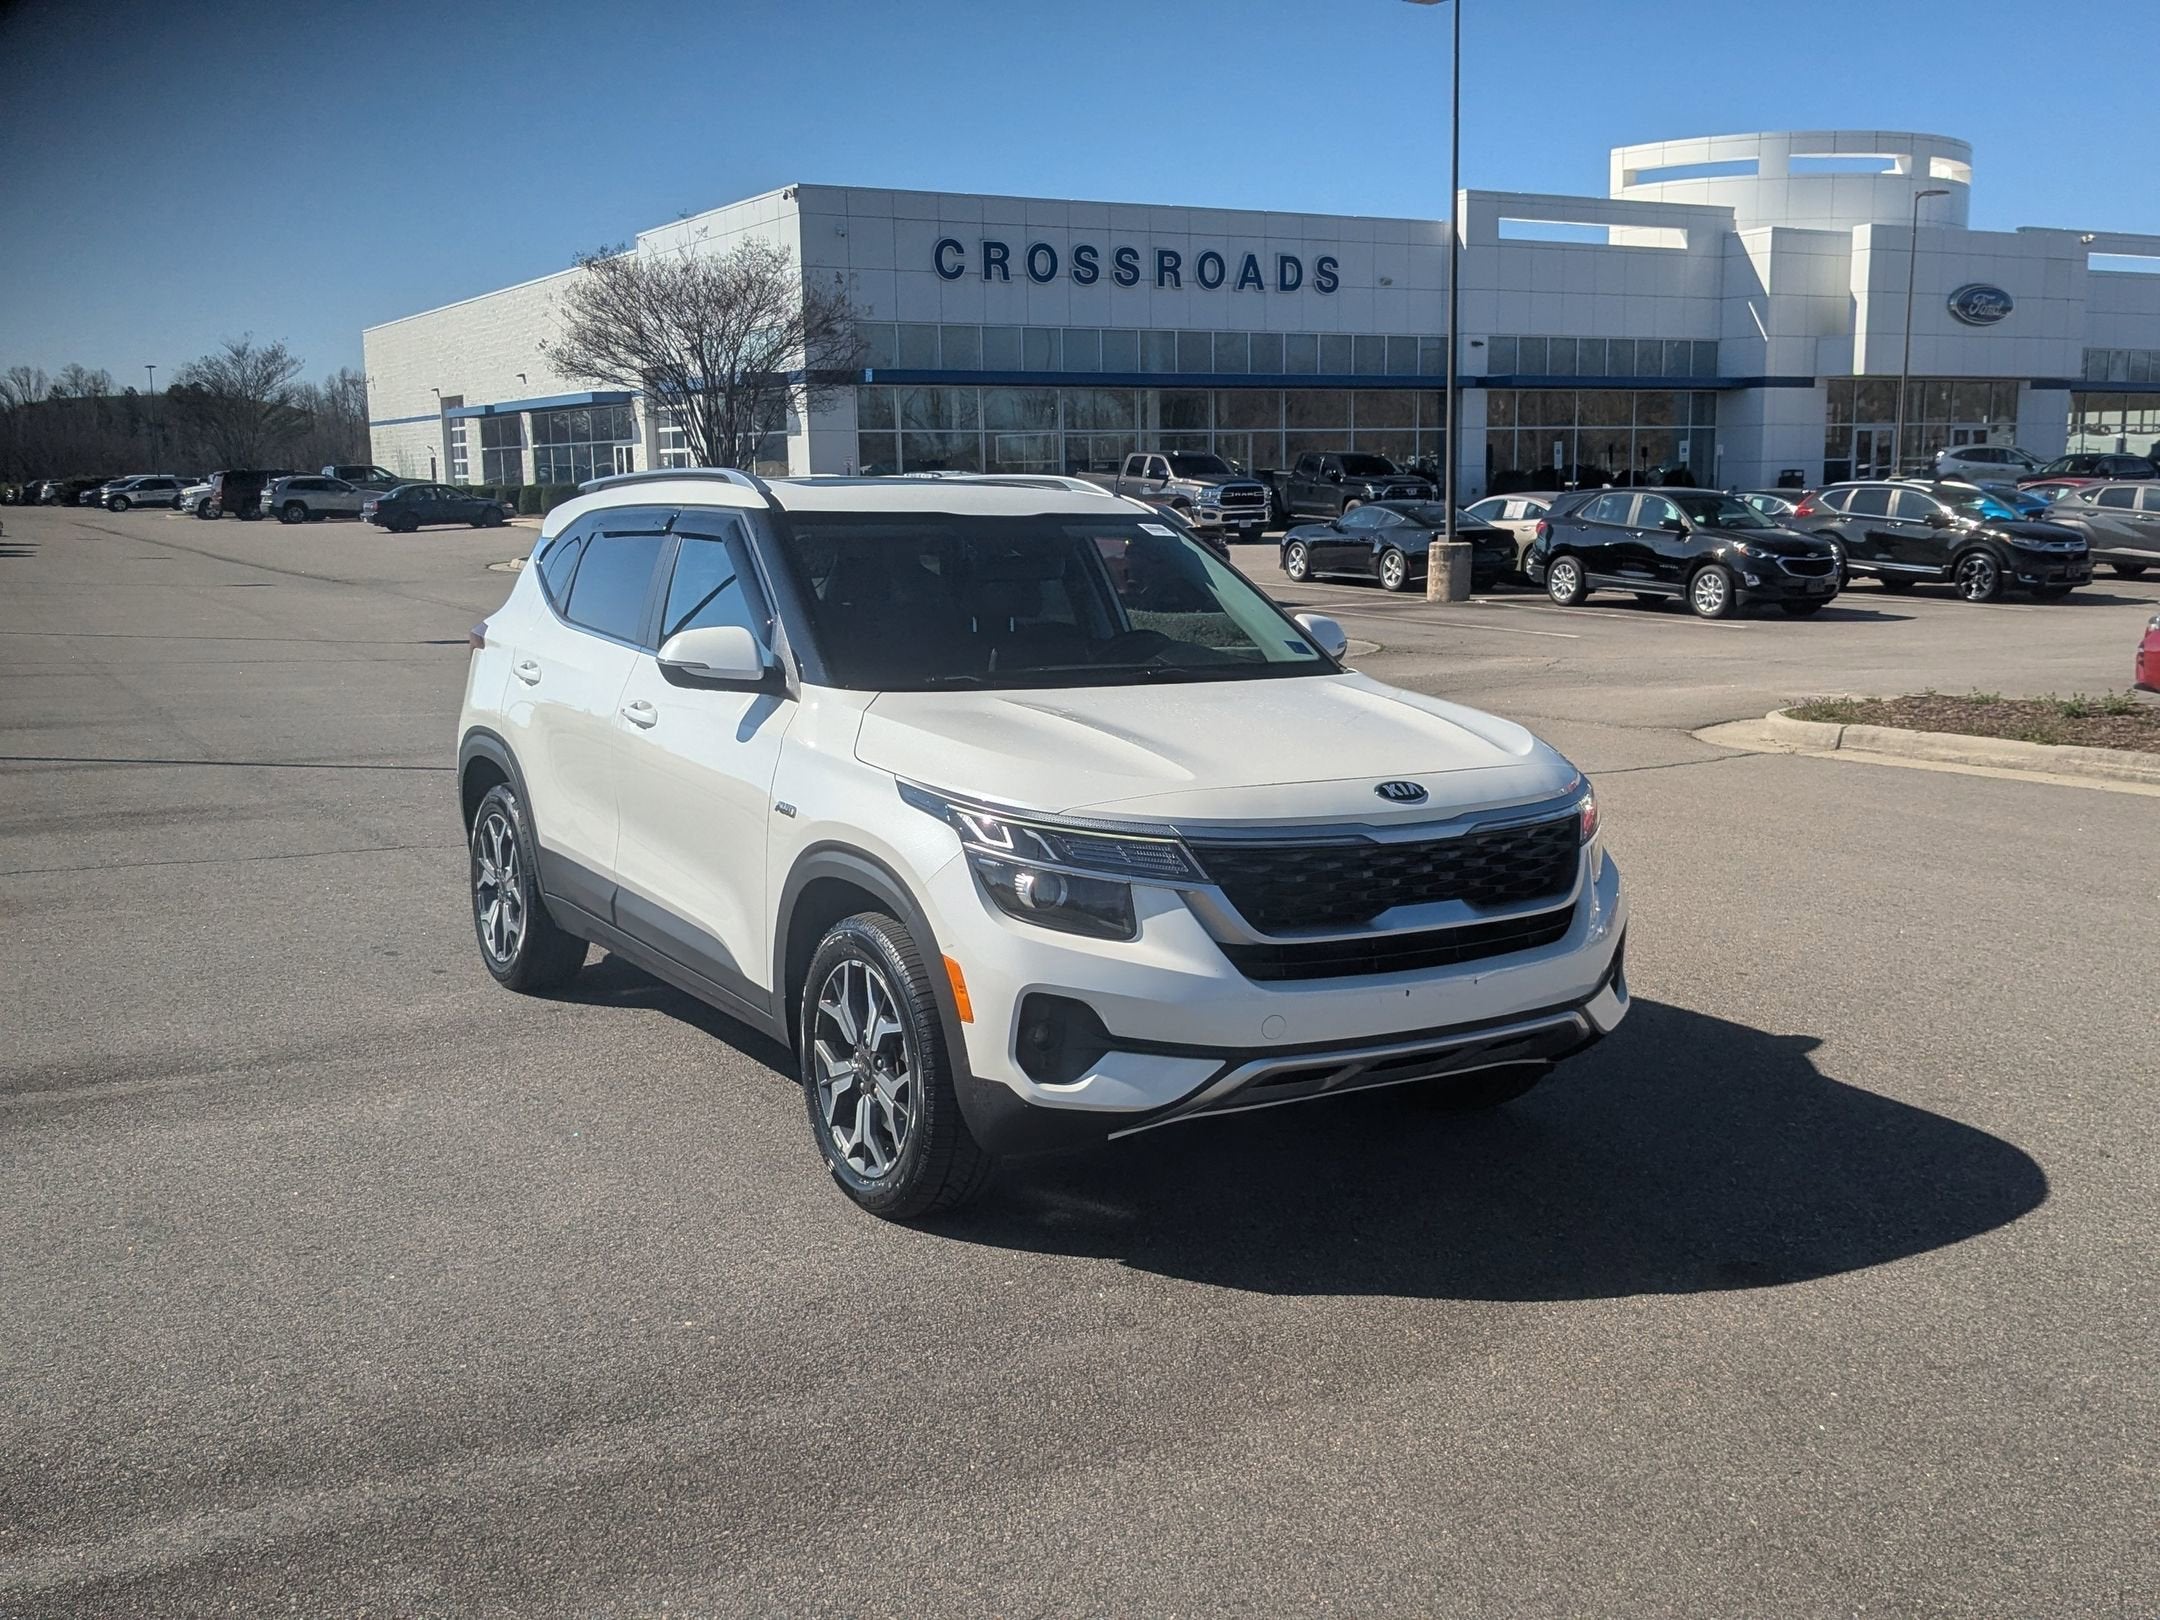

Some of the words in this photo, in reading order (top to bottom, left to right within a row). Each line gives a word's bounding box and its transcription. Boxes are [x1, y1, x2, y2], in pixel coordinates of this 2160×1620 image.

[933, 237, 1340, 295] CROSSROADS
[1968, 293, 2005, 316] Ford
[1381, 782, 1424, 798] KIA
